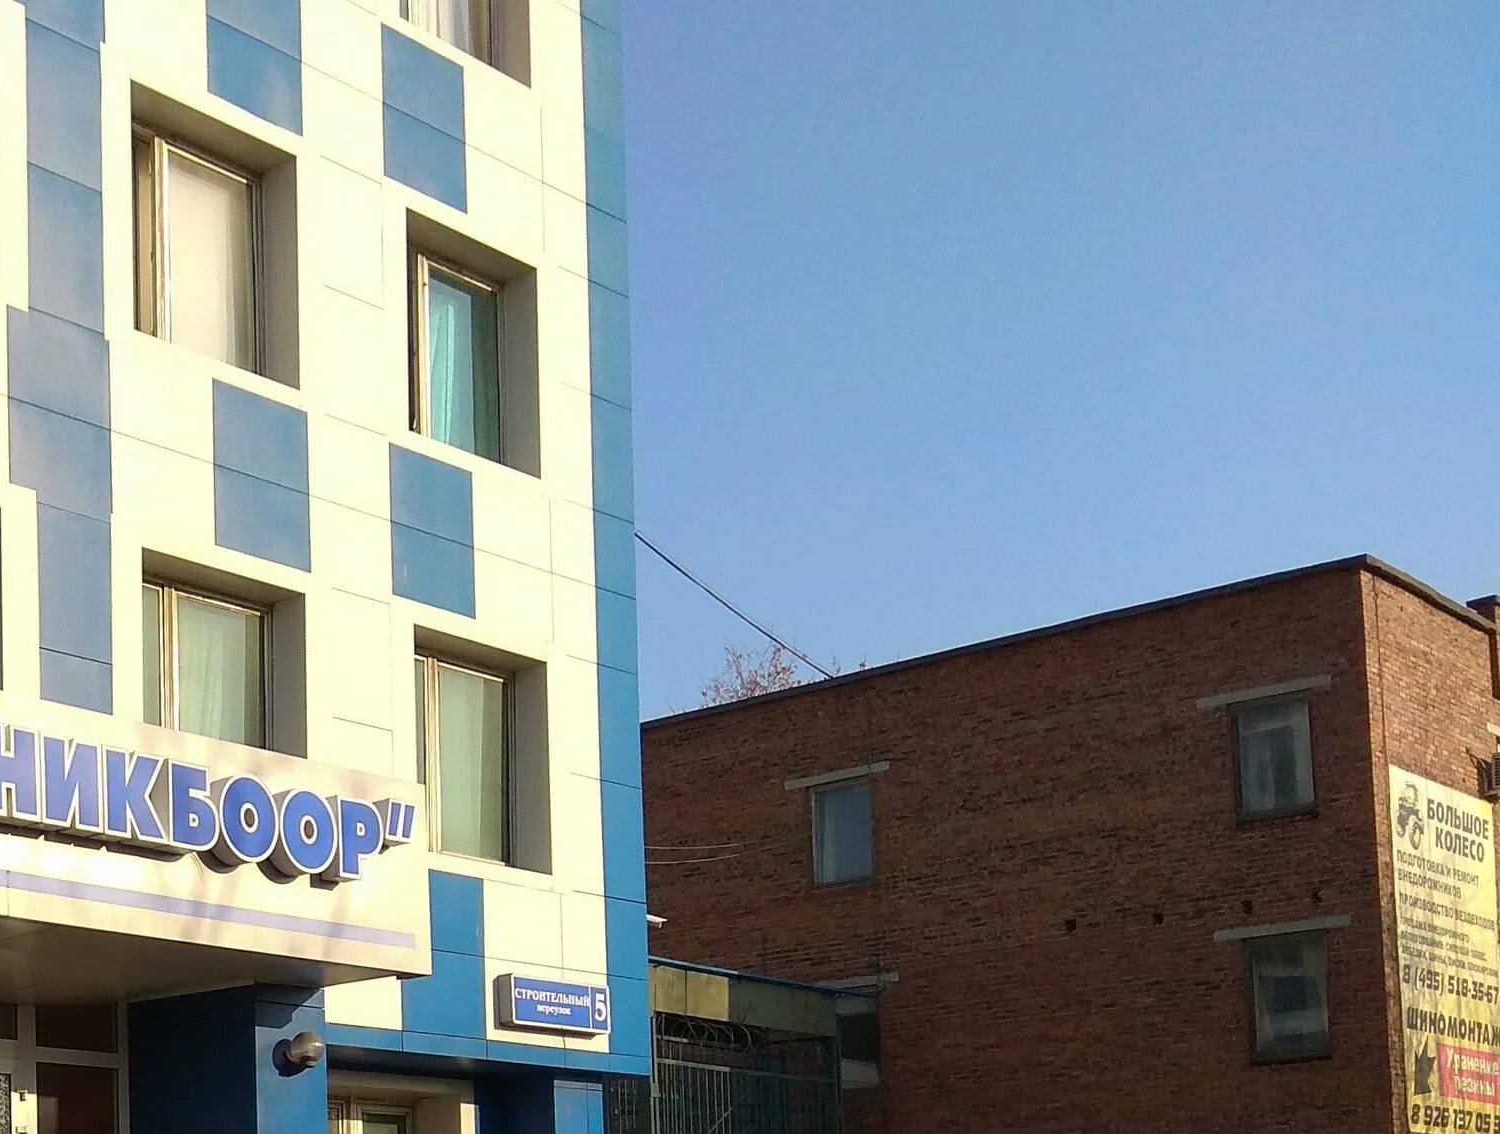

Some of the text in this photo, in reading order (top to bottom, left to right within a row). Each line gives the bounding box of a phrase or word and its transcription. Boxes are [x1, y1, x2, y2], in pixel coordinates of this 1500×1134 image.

[1426, 798, 1489, 840] БОЛЬШОЕ
[1435, 826, 1485, 863] КОЛЕСО
[1396, 849, 1479, 887] ПОДГОТОВКА И РЕМОНТ
[1398, 868, 1461, 899] ВНЕДОРОЖНИКОВ
[1399, 892, 1495, 931] ПРОИЗВОДСТВО ВЕЗДЕХОДОВ
[1403, 964, 1499, 1005] 8 (495) 518-35-67
[514, 987, 607, 1021] СТРОИТЕЛЬНЫЙ 5
[536, 1004, 572, 1016] переулок
[1406, 1006, 1500, 1047] ШИНОМОНТАЖ
[1446, 1047, 1500, 1076] Хранение
[1454, 1075, 1495, 1096] резины
[1411, 1103, 1421, 1124] 8
[1453, 1108, 1473, 1131] 137
[1475, 1112, 1491, 1133] 05
